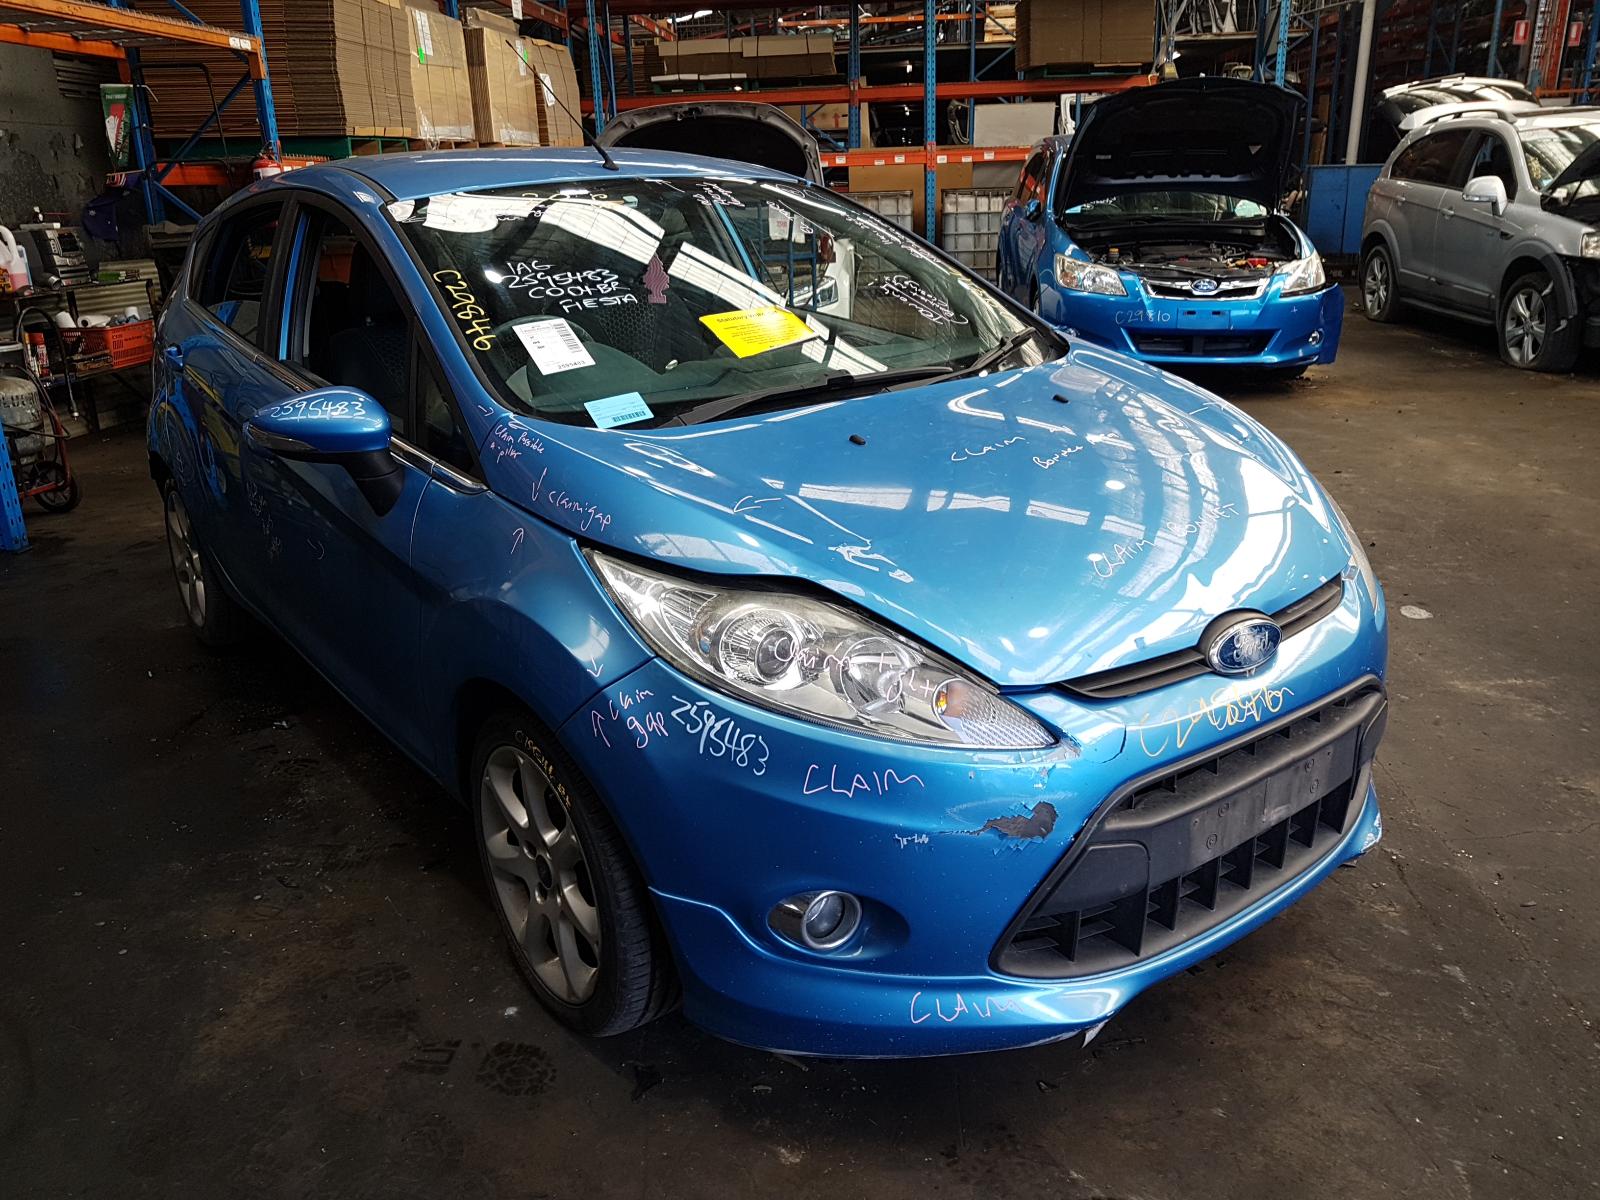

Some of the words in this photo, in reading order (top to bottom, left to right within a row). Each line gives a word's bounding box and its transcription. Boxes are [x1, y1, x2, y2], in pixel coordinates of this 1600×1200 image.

[501, 269, 619, 289] 2595483
[506, 260, 555, 275] IAG
[433, 269, 497, 351] C29846
[559, 293, 638, 314] FIESTA
[1115, 310, 1171, 325] C29810
[270, 398, 366, 422] 2595483
[626, 711, 669, 749] gap
[670, 695, 770, 776] 2595483
[803, 763, 925, 799] CLAIM
[910, 990, 1025, 1024] CLAIM
